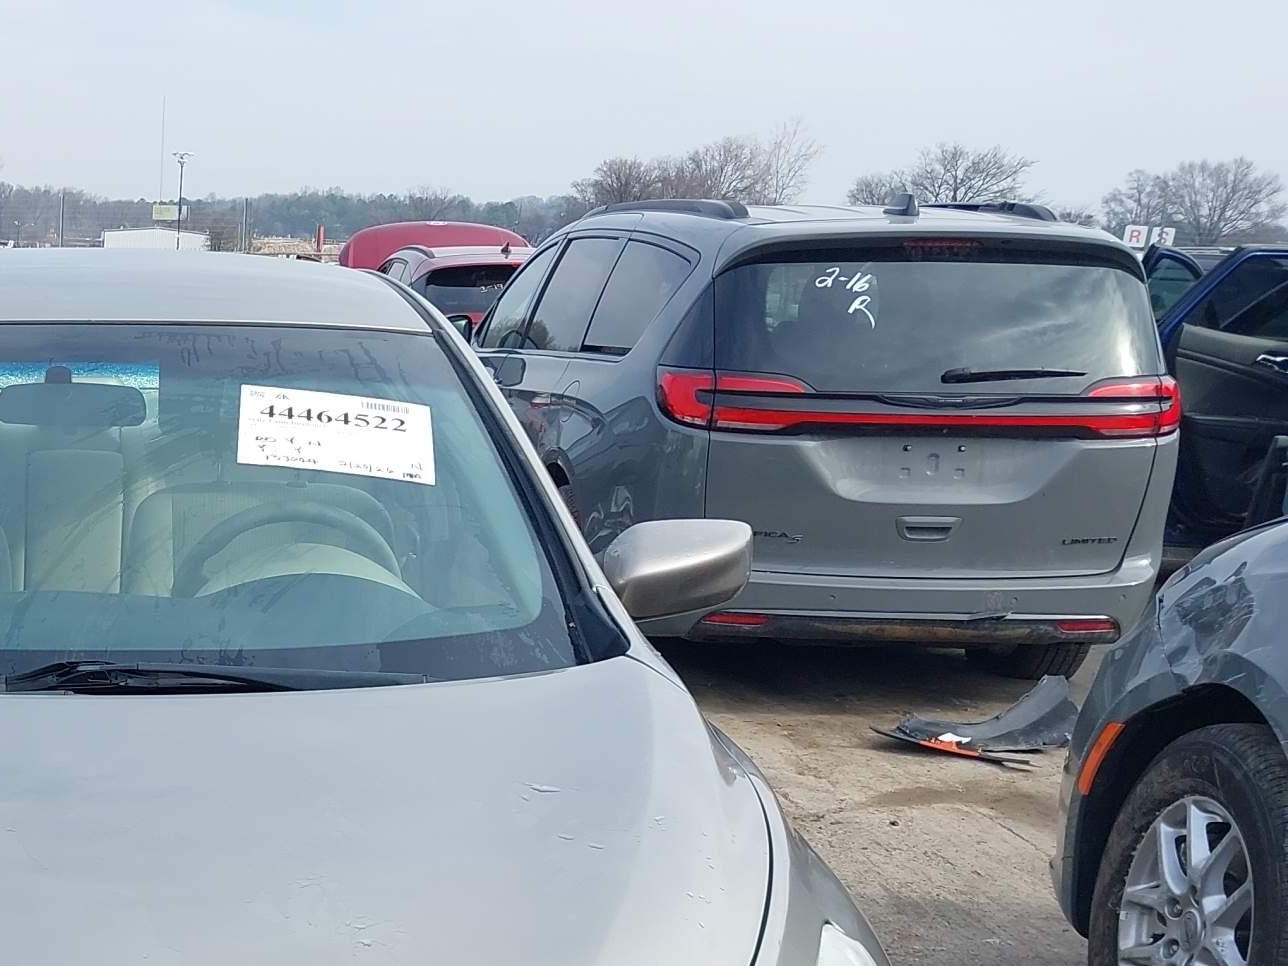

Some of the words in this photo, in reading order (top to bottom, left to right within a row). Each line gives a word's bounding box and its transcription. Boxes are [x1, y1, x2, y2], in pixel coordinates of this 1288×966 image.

[1128, 229, 1142, 243] R
[815, 266, 873, 293] 2-16
[847, 295, 876, 329] R
[259, 404, 408, 433] 44464522
